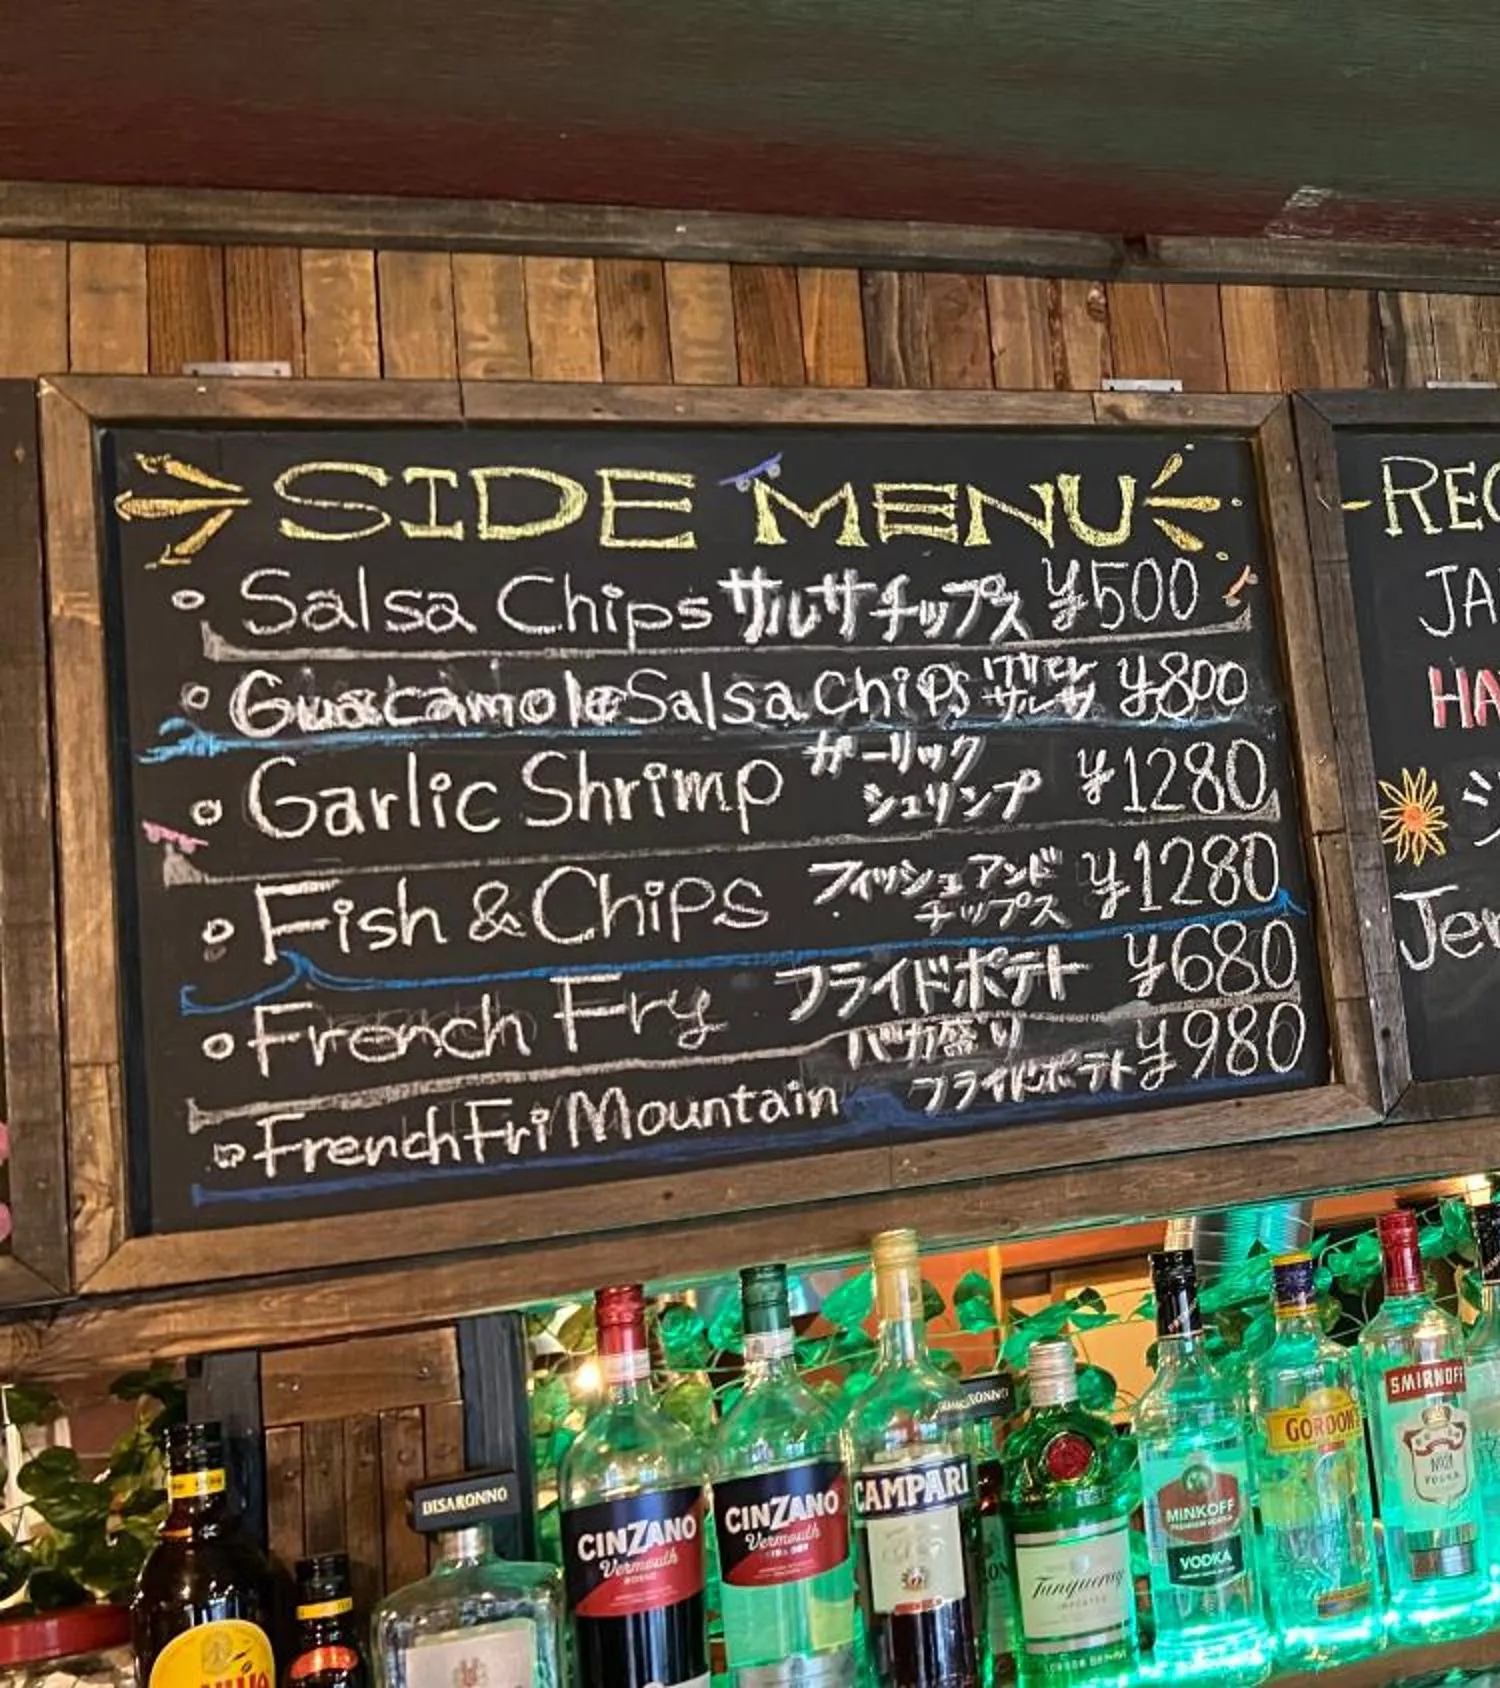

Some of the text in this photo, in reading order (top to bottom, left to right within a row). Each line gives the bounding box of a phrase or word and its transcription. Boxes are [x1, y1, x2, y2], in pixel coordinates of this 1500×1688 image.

[273, 460, 1138, 549] SIDE MENU
[241, 556, 1200, 651] Salsa Chips サルサチップス ¥500
[1117, 651, 1248, 727] ¥800
[247, 749, 784, 839] Garlic Shrimp
[1077, 738, 1268, 816] ¥1280
[254, 866, 770, 966] Fish & Chips
[1083, 831, 1281, 920] ¥1280
[775, 919, 1298, 1021] フライドポテト ¥680
[249, 973, 728, 1078] French Fry
[1134, 1001, 1307, 1091] ¥980
[422, 1486, 508, 1516] DISARONNO
[725, 1489, 839, 1534] CINZANO
[854, 1463, 972, 1514] CAMPARI
[1165, 1498, 1235, 1524] MINKOFF
[577, 1514, 697, 1561] CINZANO
[1179, 1549, 1233, 1571] VODKA
